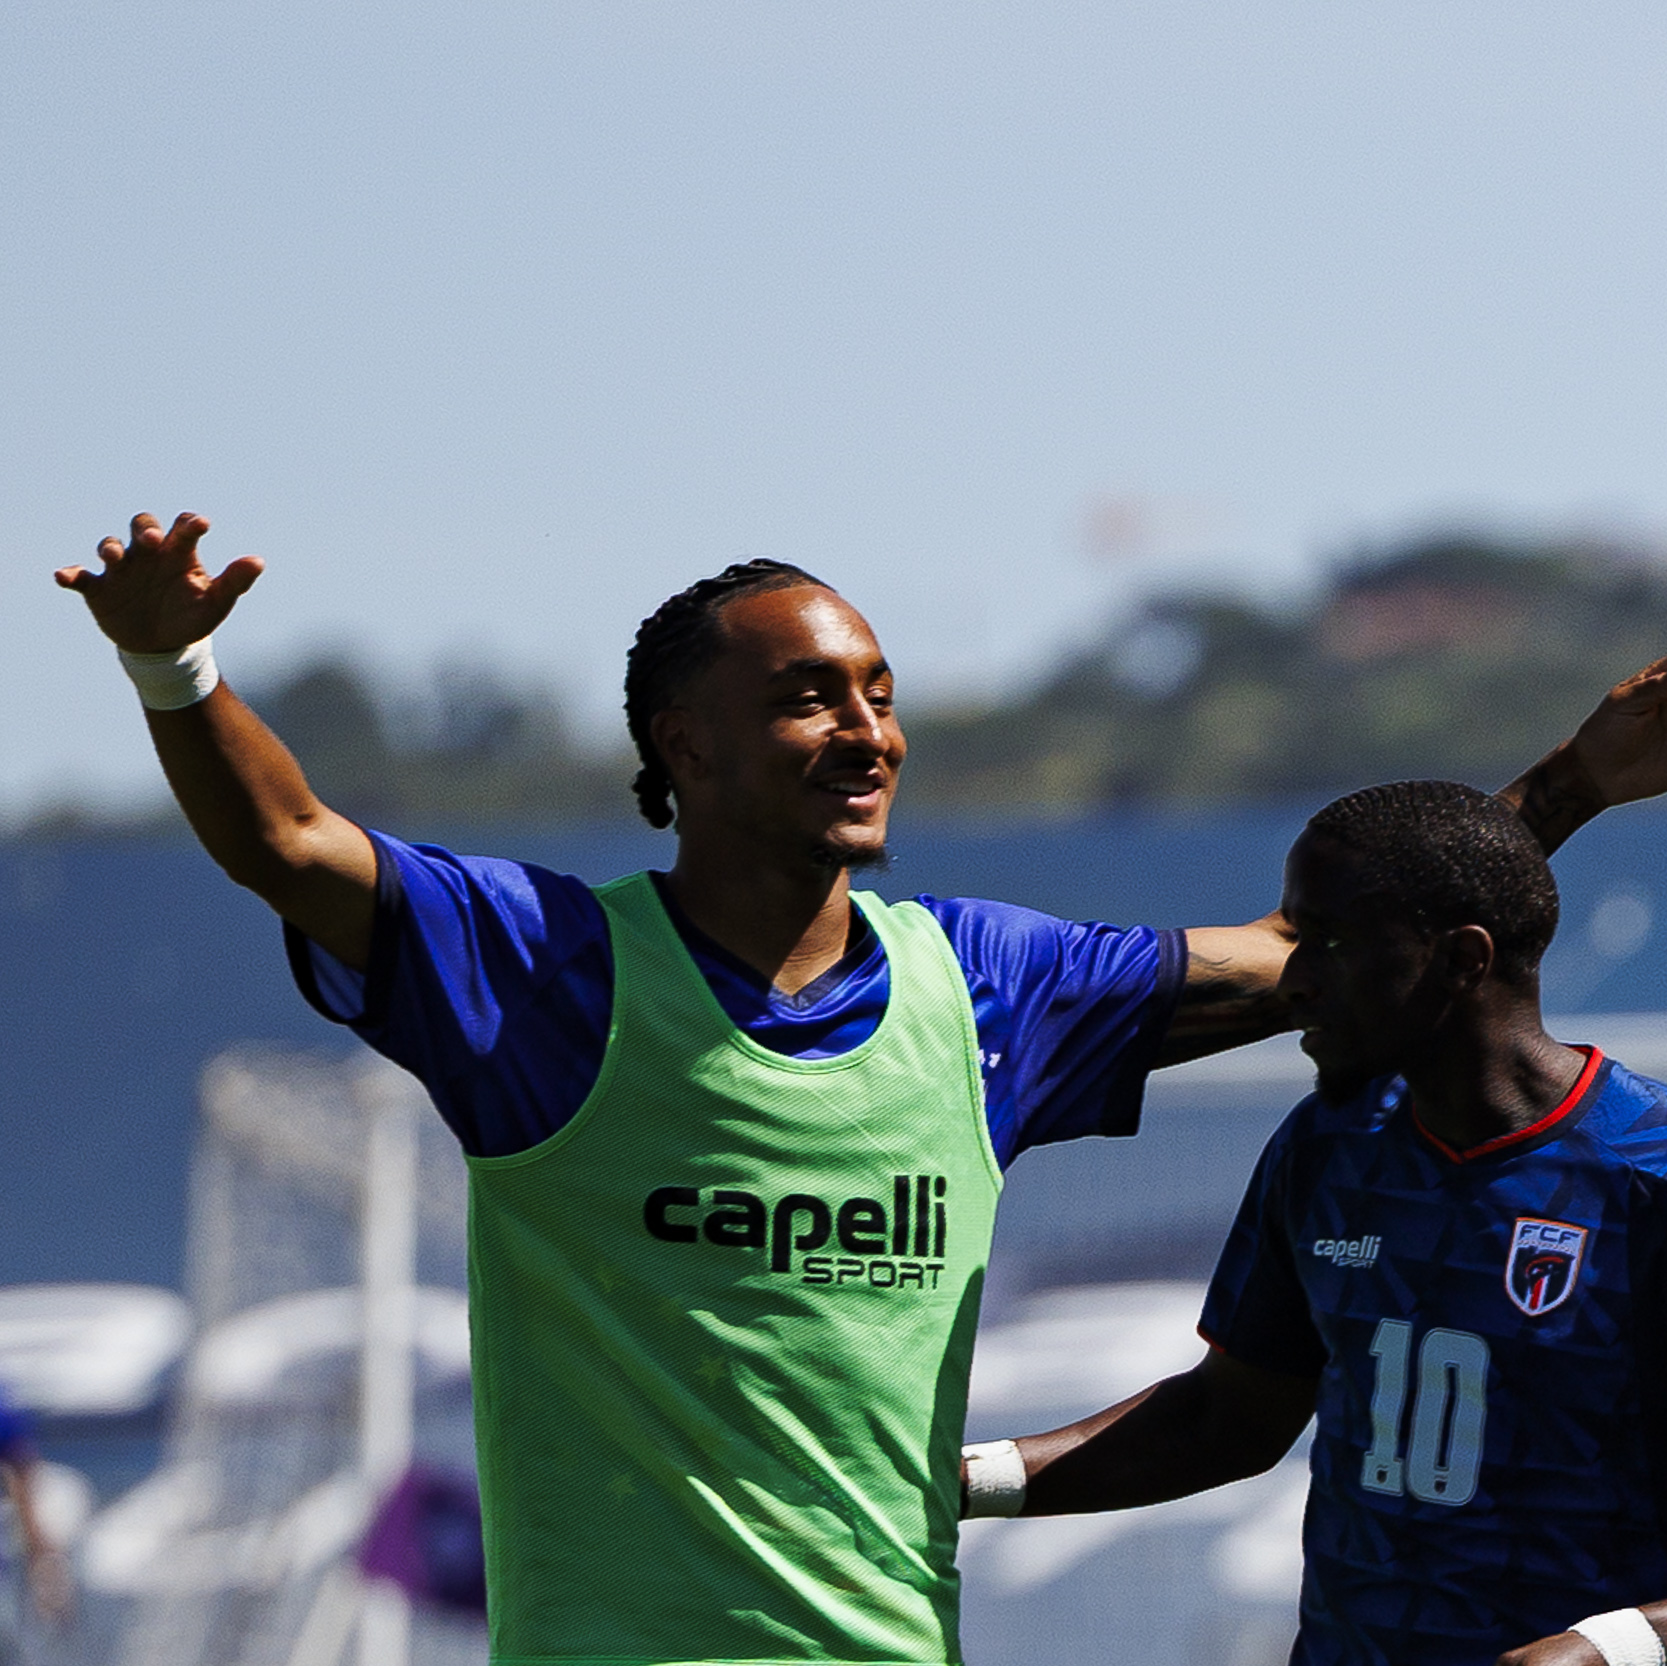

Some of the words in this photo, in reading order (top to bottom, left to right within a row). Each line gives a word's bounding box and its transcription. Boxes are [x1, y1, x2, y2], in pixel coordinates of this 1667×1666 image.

[643, 1174, 947, 1273] capelli
[1521, 1224, 1580, 1244] FCF
[1313, 1235, 1382, 1264] capelli
[802, 1256, 945, 1290] SPORT
[1360, 1317, 1491, 1507] 10
